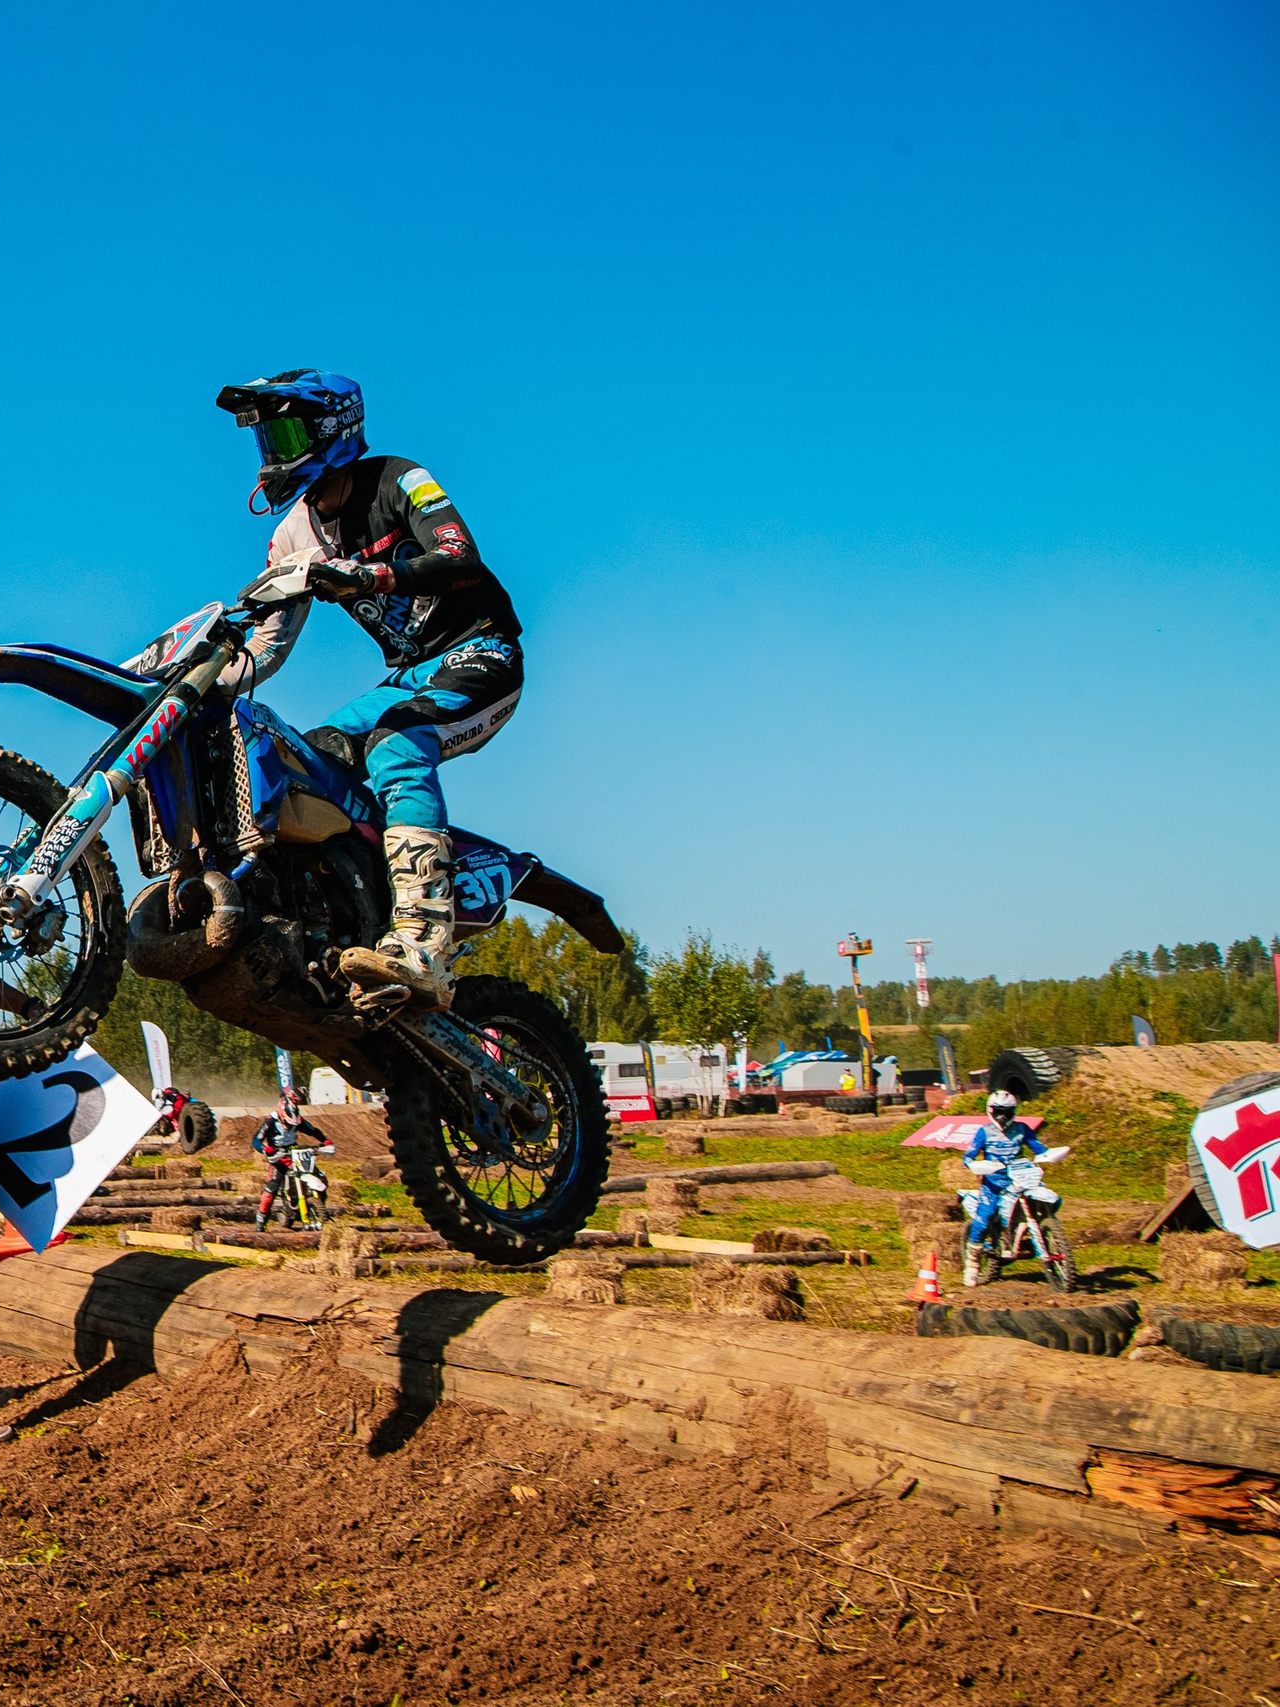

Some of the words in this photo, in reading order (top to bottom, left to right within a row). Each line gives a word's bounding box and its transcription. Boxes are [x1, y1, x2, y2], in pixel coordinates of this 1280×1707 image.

[126, 704, 181, 774] KYB
[48, 831, 72, 846] ave
[61, 828, 79, 839] THE
[46, 843, 65, 852] AND
[454, 864, 512, 910] 317
